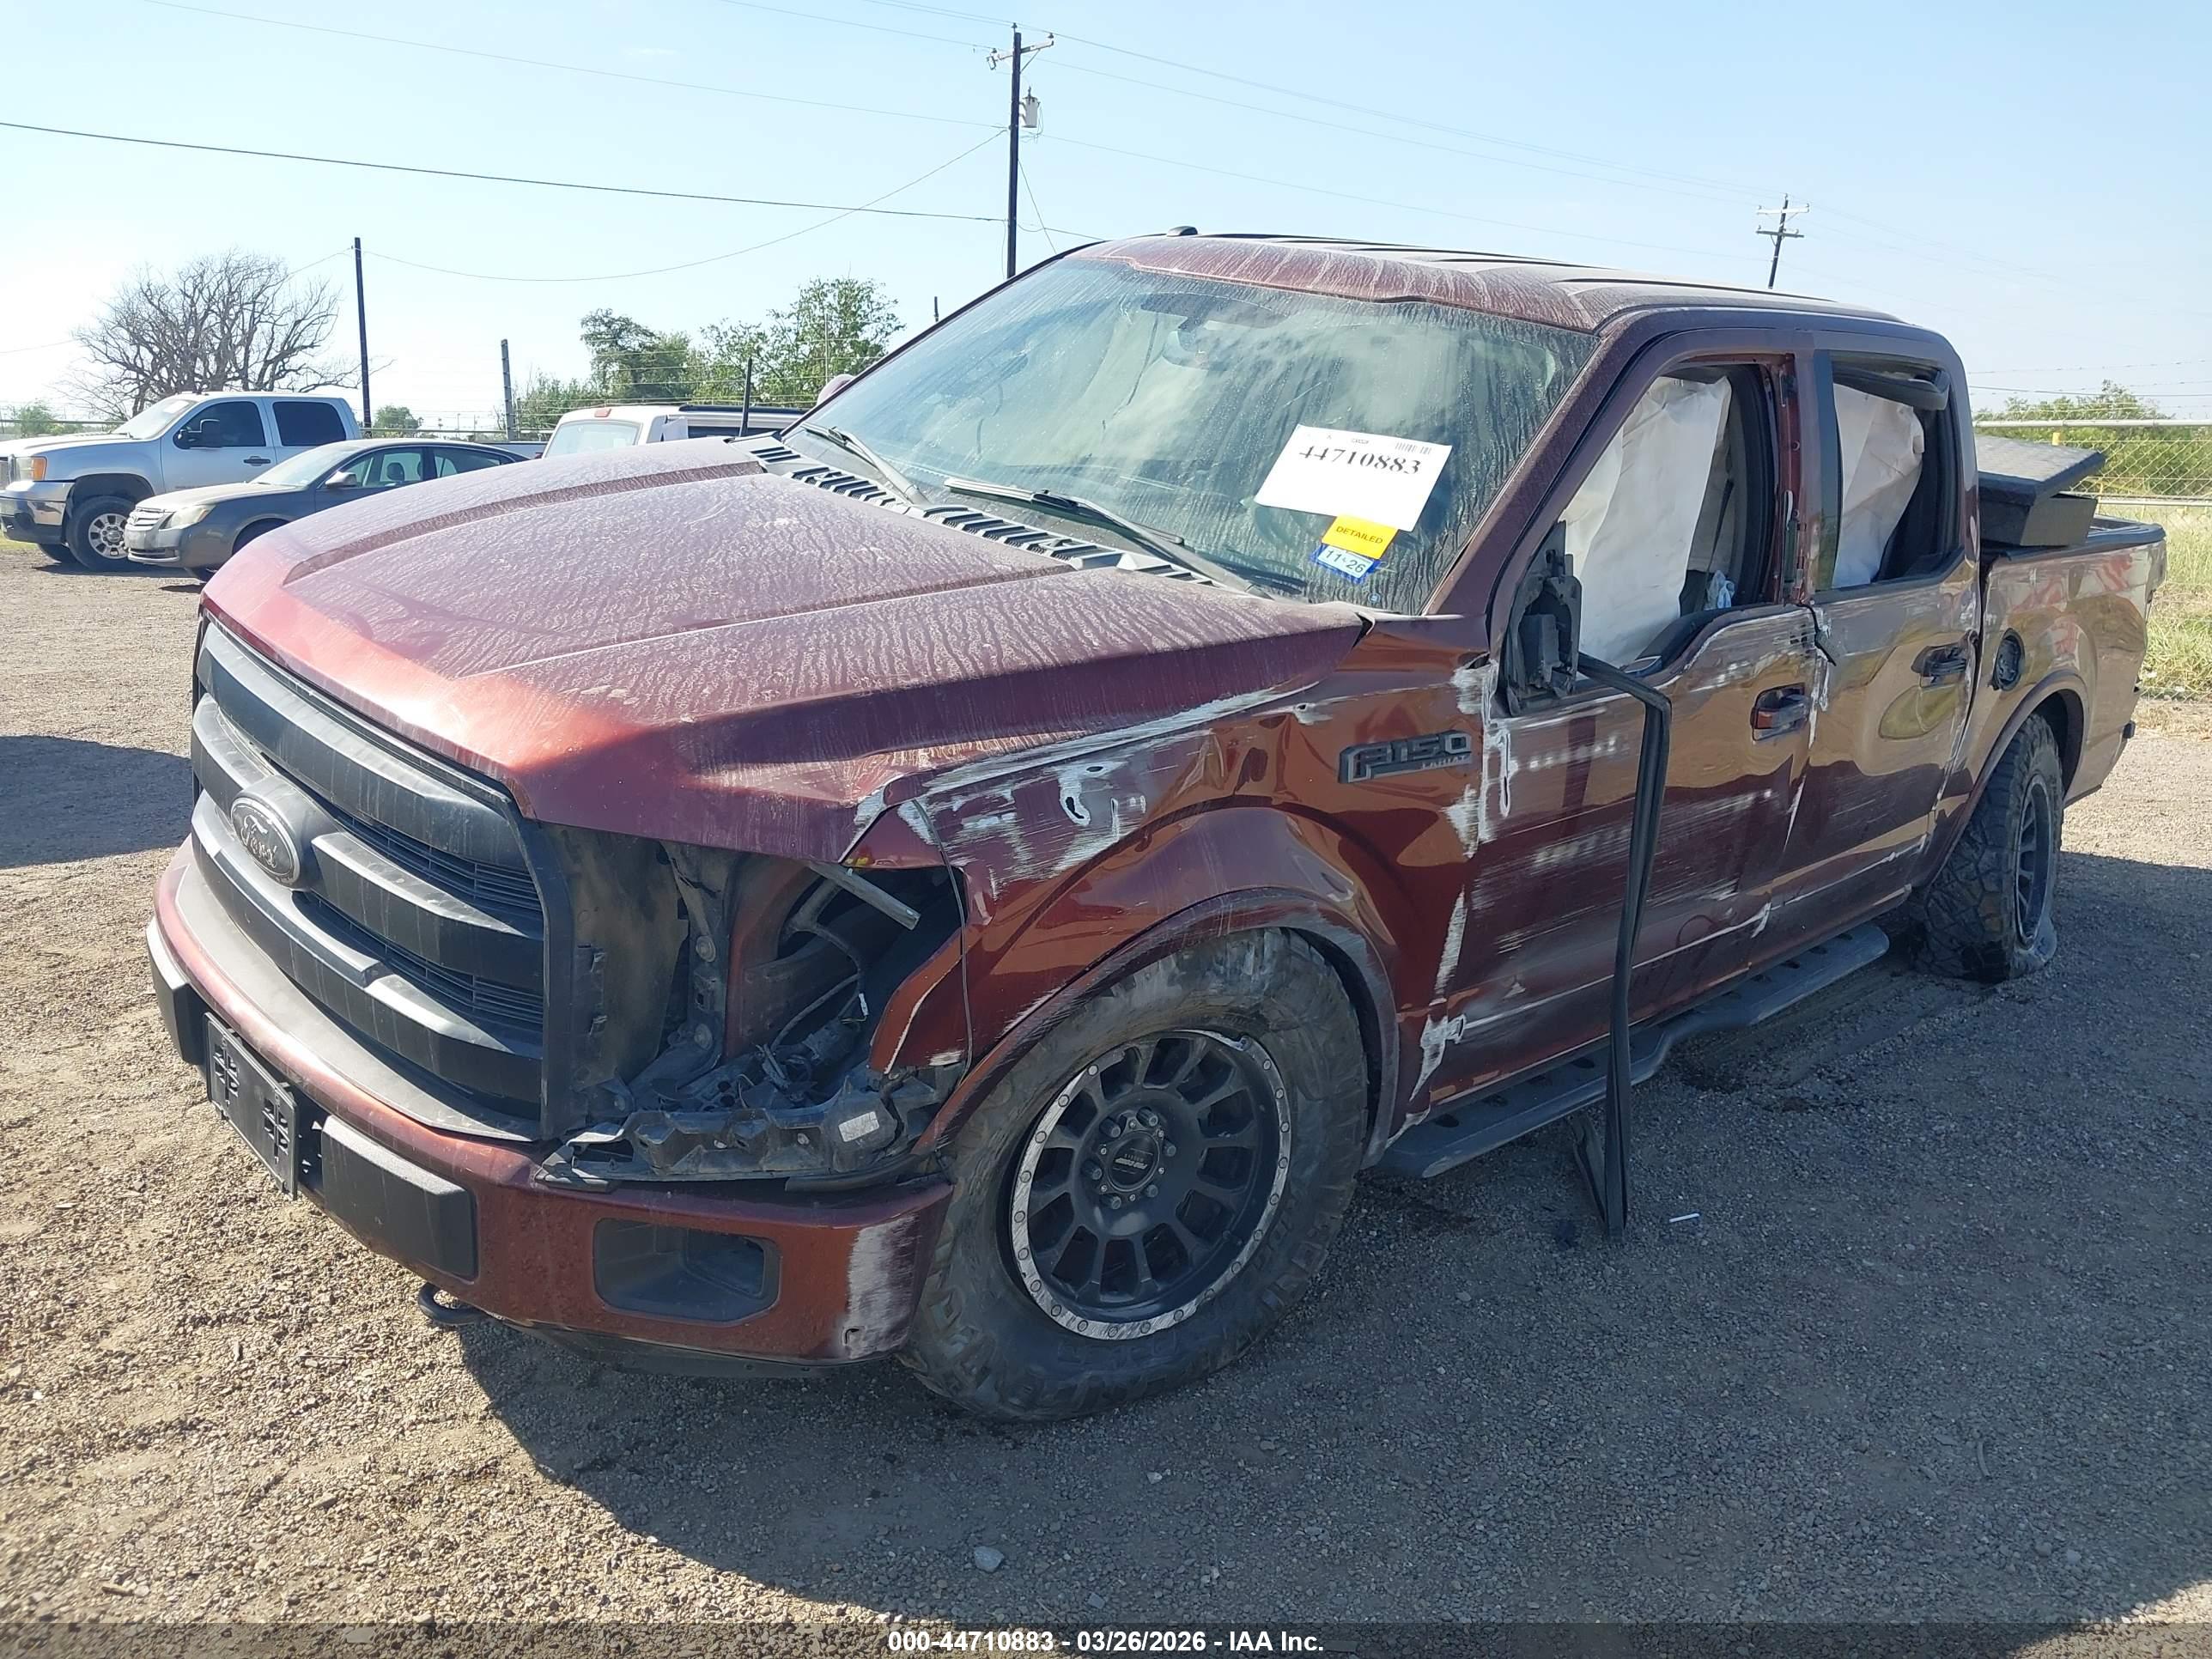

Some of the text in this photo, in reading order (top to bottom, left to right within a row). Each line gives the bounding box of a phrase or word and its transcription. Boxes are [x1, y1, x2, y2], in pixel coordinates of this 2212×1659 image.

[1299, 446, 1421, 474] 44710883
[1336, 526, 1383, 544] DETAILED
[240, 815, 277, 869] Ford
